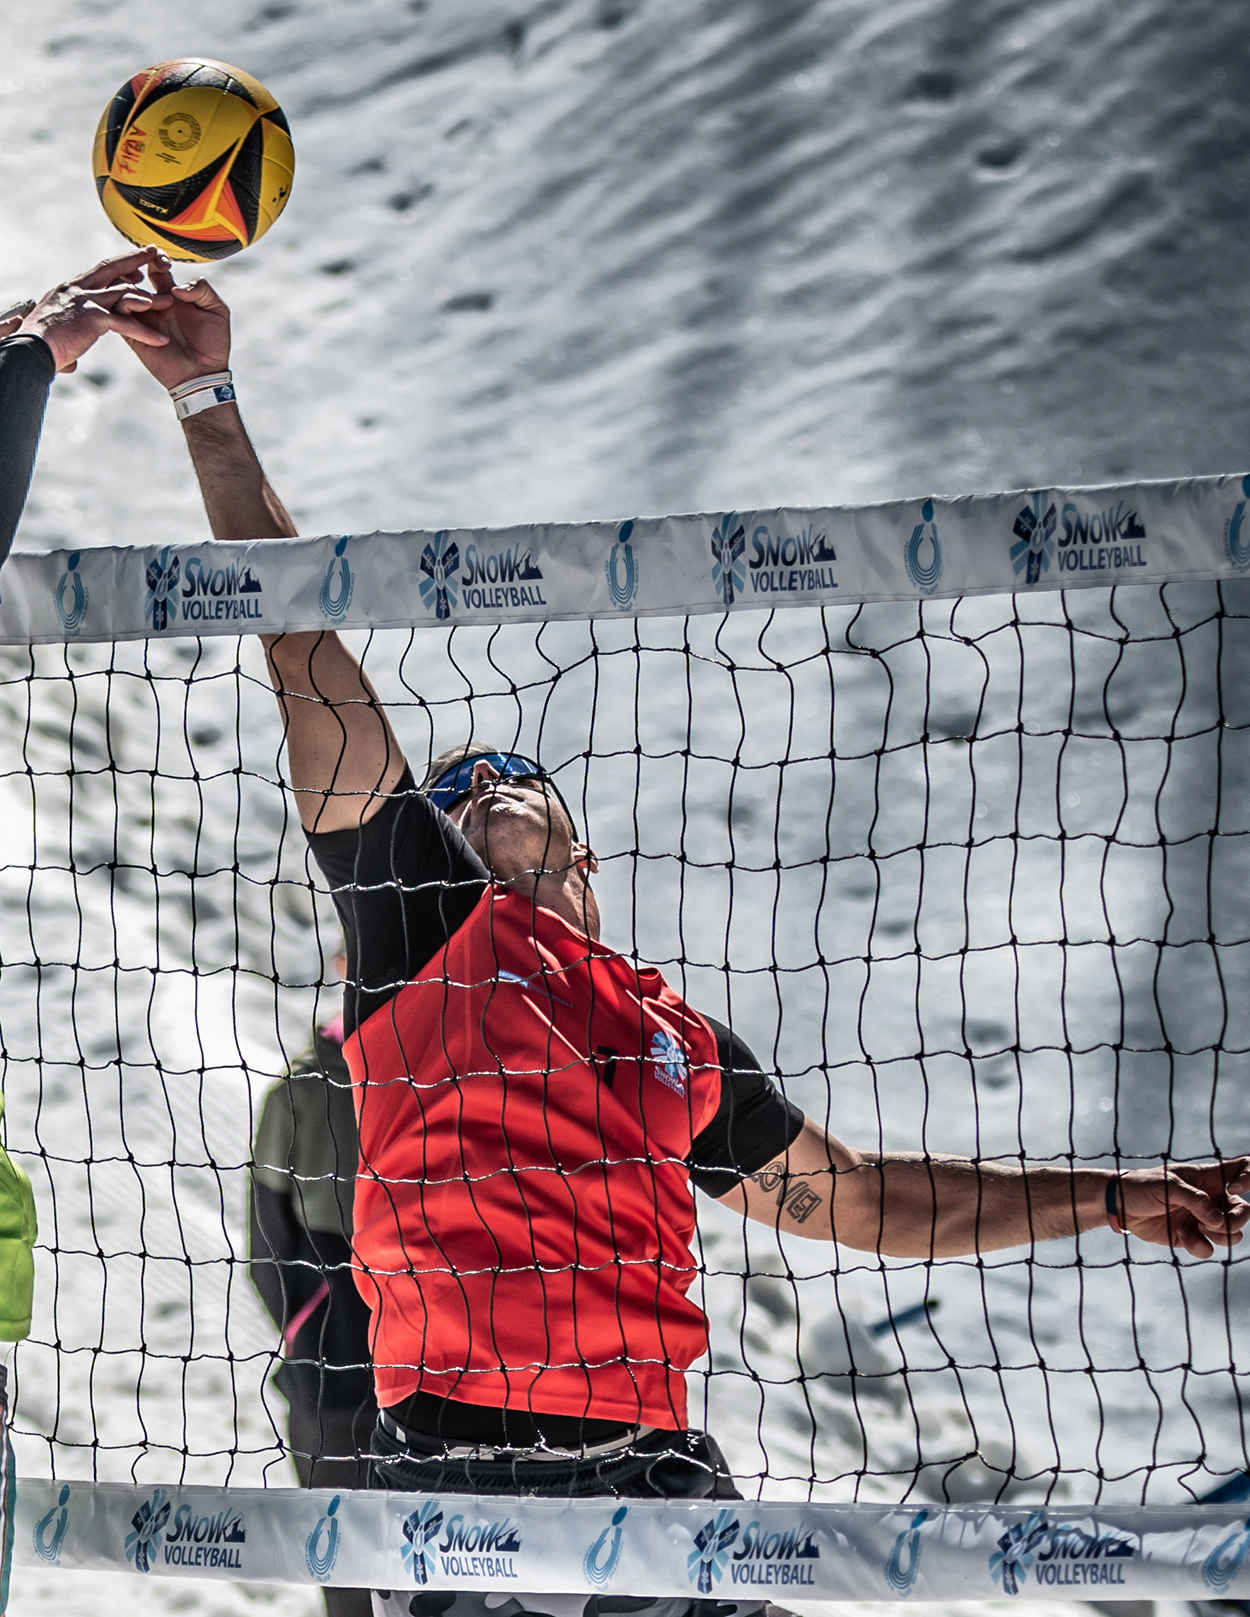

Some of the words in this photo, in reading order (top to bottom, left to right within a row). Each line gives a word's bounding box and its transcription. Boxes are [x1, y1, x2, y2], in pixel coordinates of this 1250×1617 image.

[1058, 500, 1124, 547] SNOW
[462, 543, 519, 586] SNOW
[749, 524, 813, 569] SNOW
[1058, 545, 1147, 571] VOLLEYBALL
[182, 556, 241, 597] SNOW
[751, 567, 838, 592] VOLLEYBALL
[182, 599, 262, 620] VOLLEYBALL
[463, 586, 546, 609] VOLLEYBALL
[750, 1161, 823, 1224] OVE
[166, 1504, 233, 1543] SNOW
[439, 1514, 510, 1552] SNOW
[733, 1521, 806, 1560] SNOW
[164, 1545, 242, 1568] VOLLEYBALL
[1038, 1525, 1113, 1561] SNOW
[440, 1556, 518, 1578] VOLLEYBALL
[731, 1563, 815, 1585] VOLLEYBALL
[1035, 1563, 1125, 1585] VOLLEYBALL
